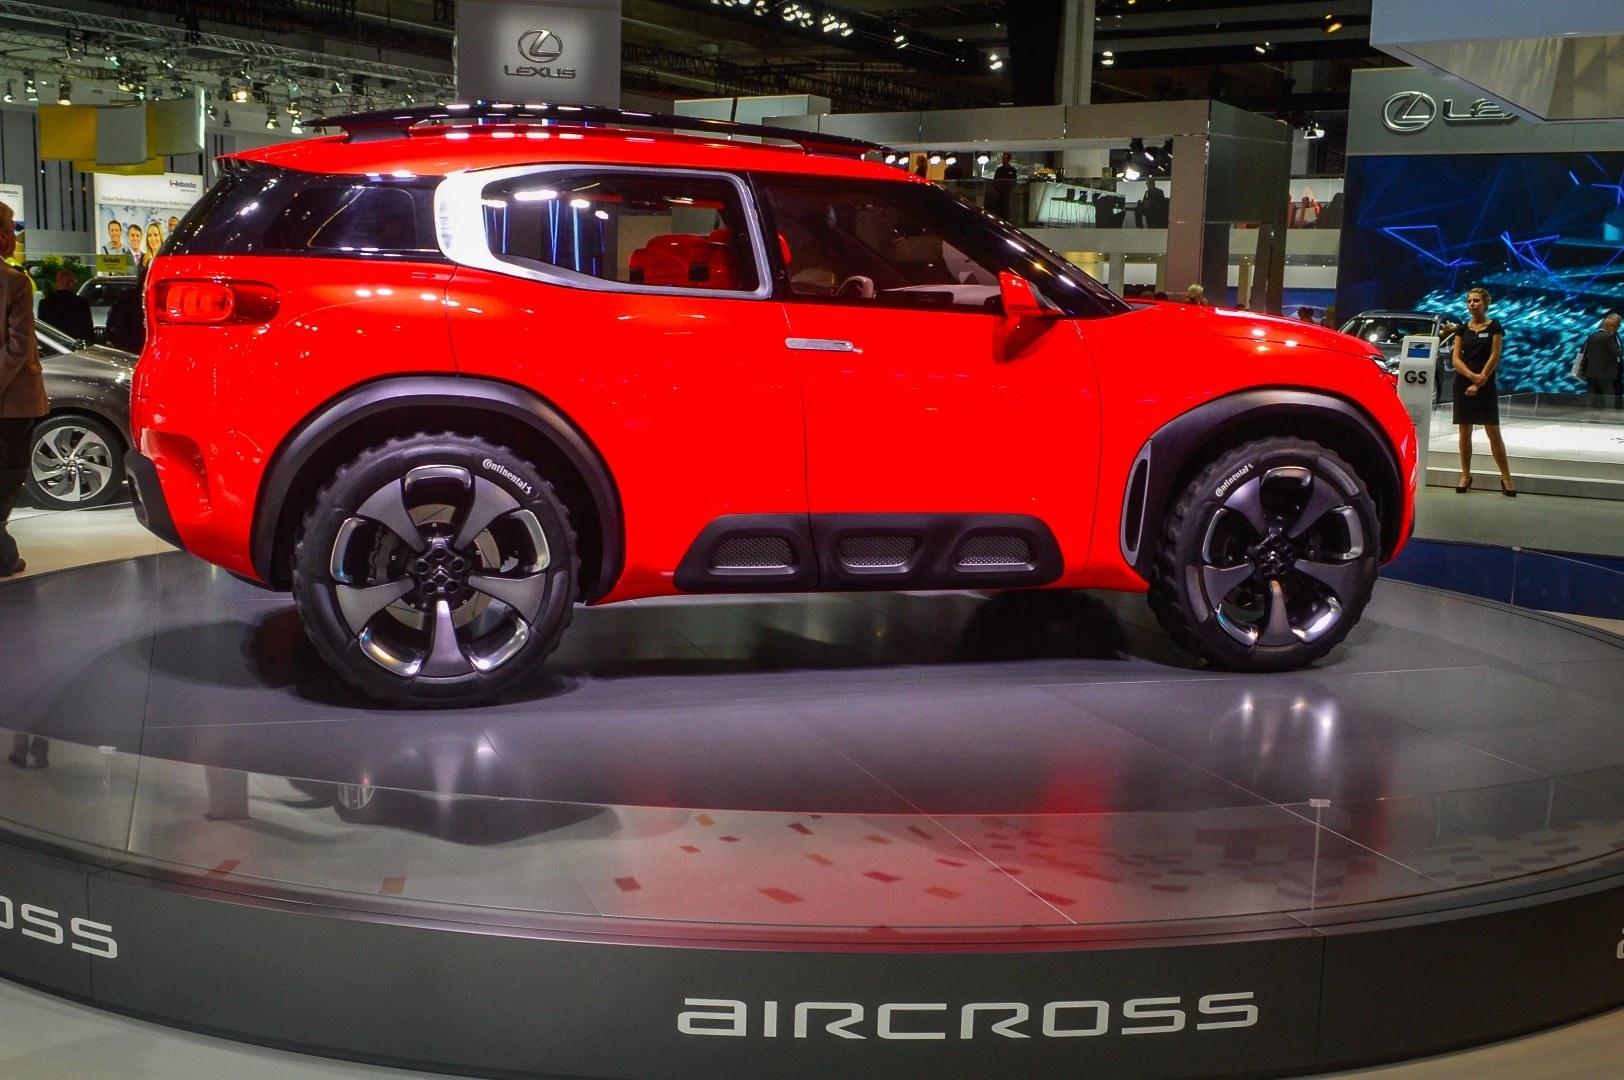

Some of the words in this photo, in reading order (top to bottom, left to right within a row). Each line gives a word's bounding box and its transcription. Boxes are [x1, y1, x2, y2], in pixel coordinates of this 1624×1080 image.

[504, 64, 576, 79] LEXUS
[1443, 98, 1516, 122] LE
[169, 179, 197, 189] Webasto
[1404, 370, 1427, 385] GS
[482, 458, 528, 490] Continental
[1215, 465, 1249, 497] Continental
